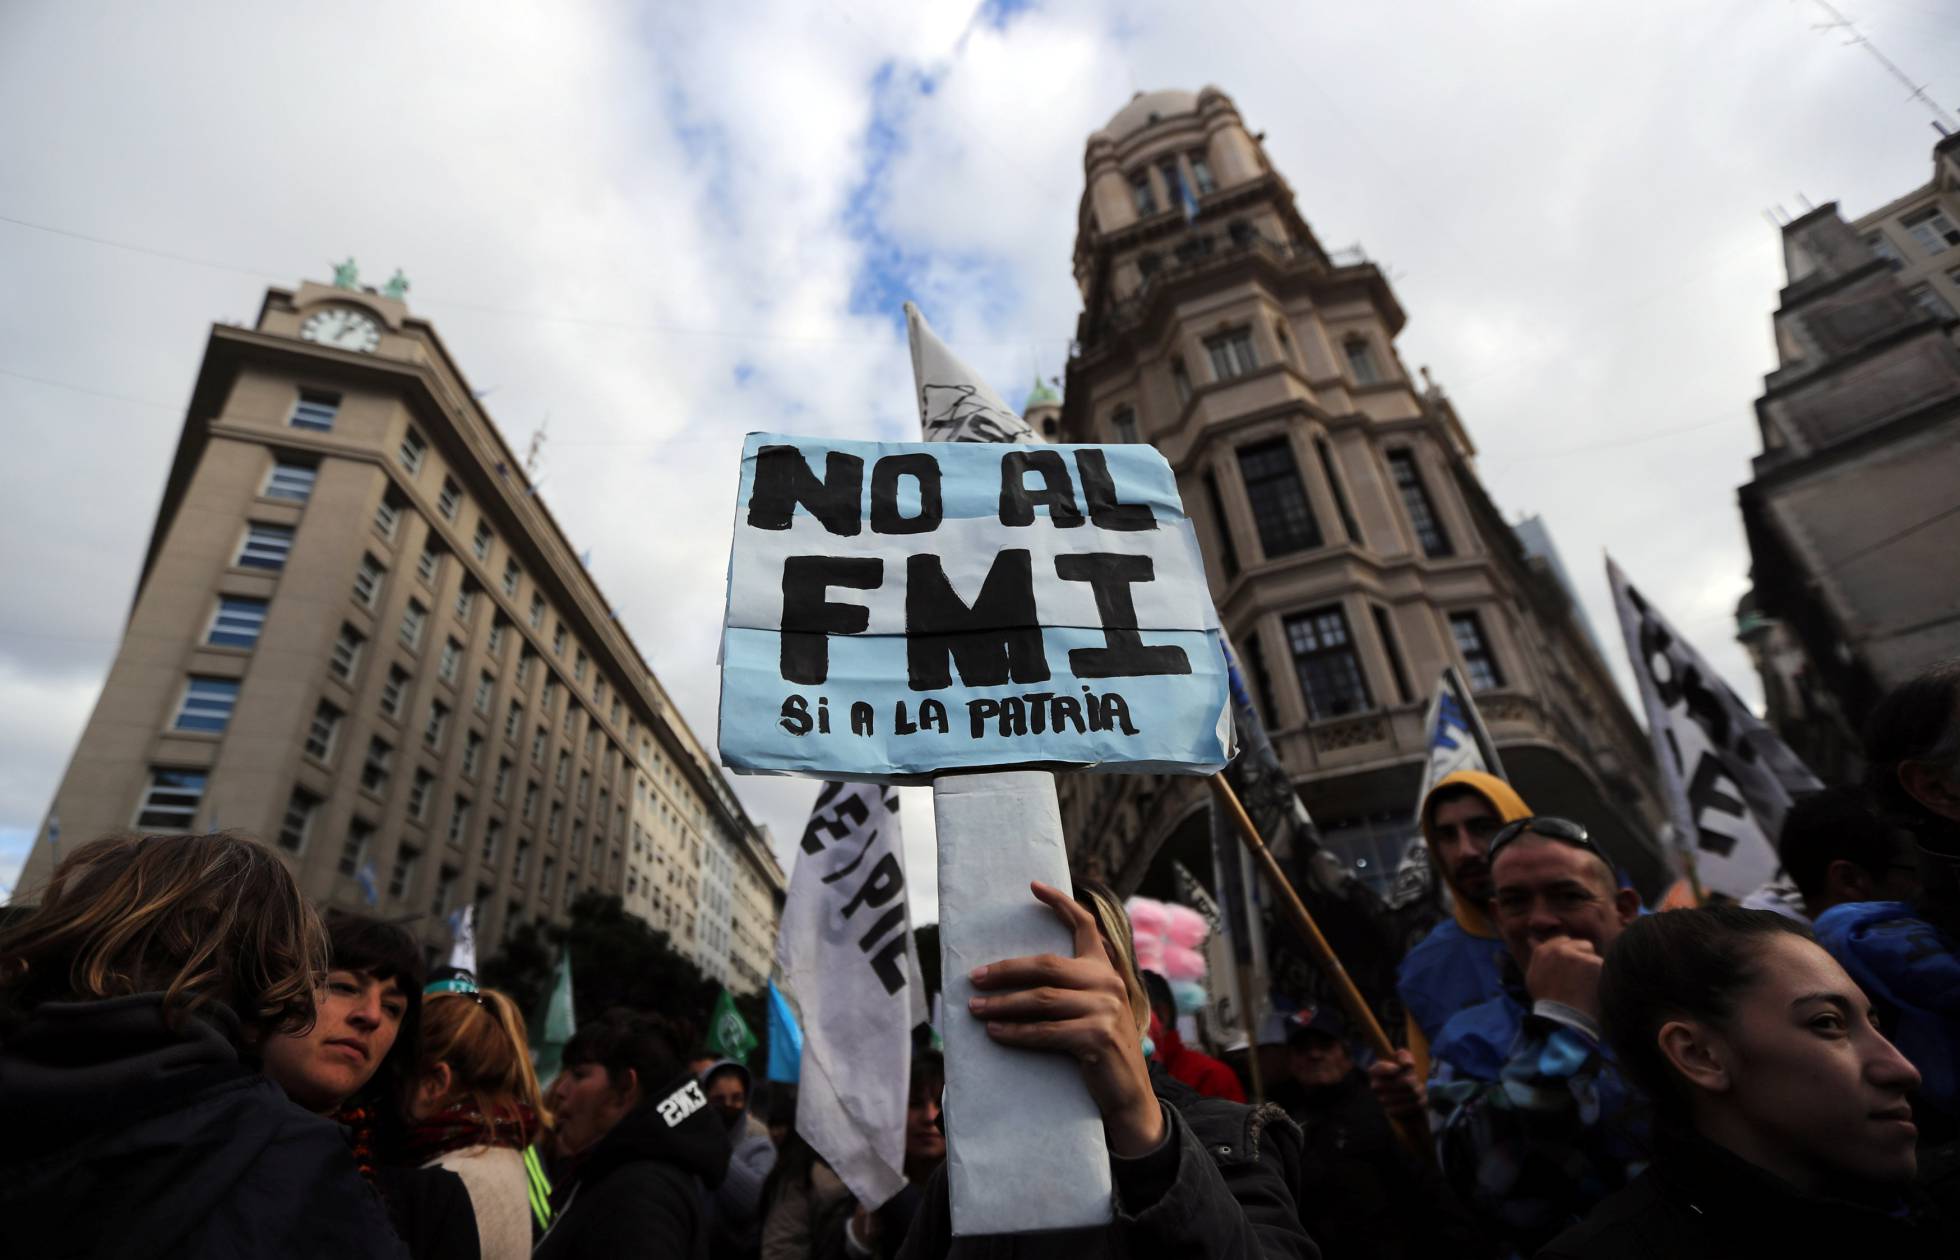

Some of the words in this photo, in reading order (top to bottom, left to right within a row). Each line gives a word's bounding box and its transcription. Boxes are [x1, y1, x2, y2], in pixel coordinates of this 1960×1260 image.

[747, 445, 943, 537] NO
[999, 449, 1160, 532] AL
[780, 548, 1193, 691] FMI
[850, 700, 875, 738] A
[894, 699, 949, 737] LA
